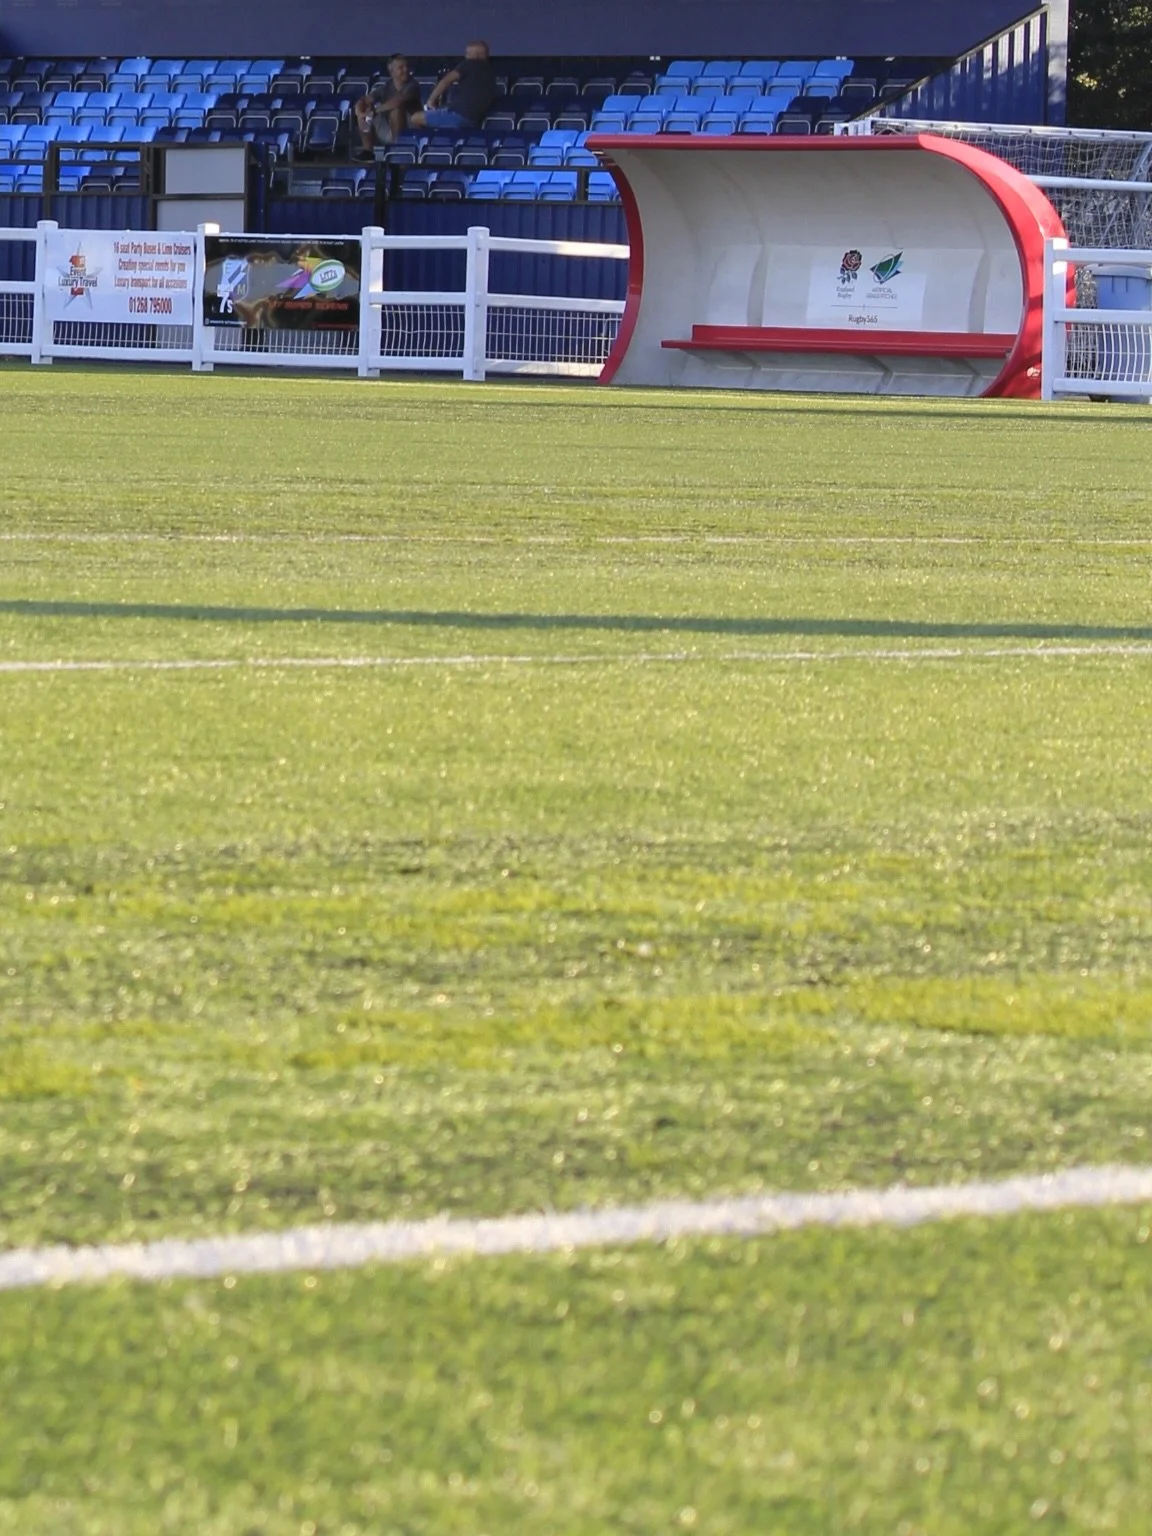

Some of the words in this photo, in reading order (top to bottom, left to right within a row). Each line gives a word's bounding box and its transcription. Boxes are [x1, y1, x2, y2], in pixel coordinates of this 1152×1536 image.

[131, 242, 143, 256] Party
[174, 243, 191, 255] Cruisers
[58, 276, 79, 287] Luxury
[80, 277, 98, 287] Travel
[129, 297, 148, 313] 01268
[150, 297, 172, 314] 795000
[849, 315, 878, 324] Rugby365
